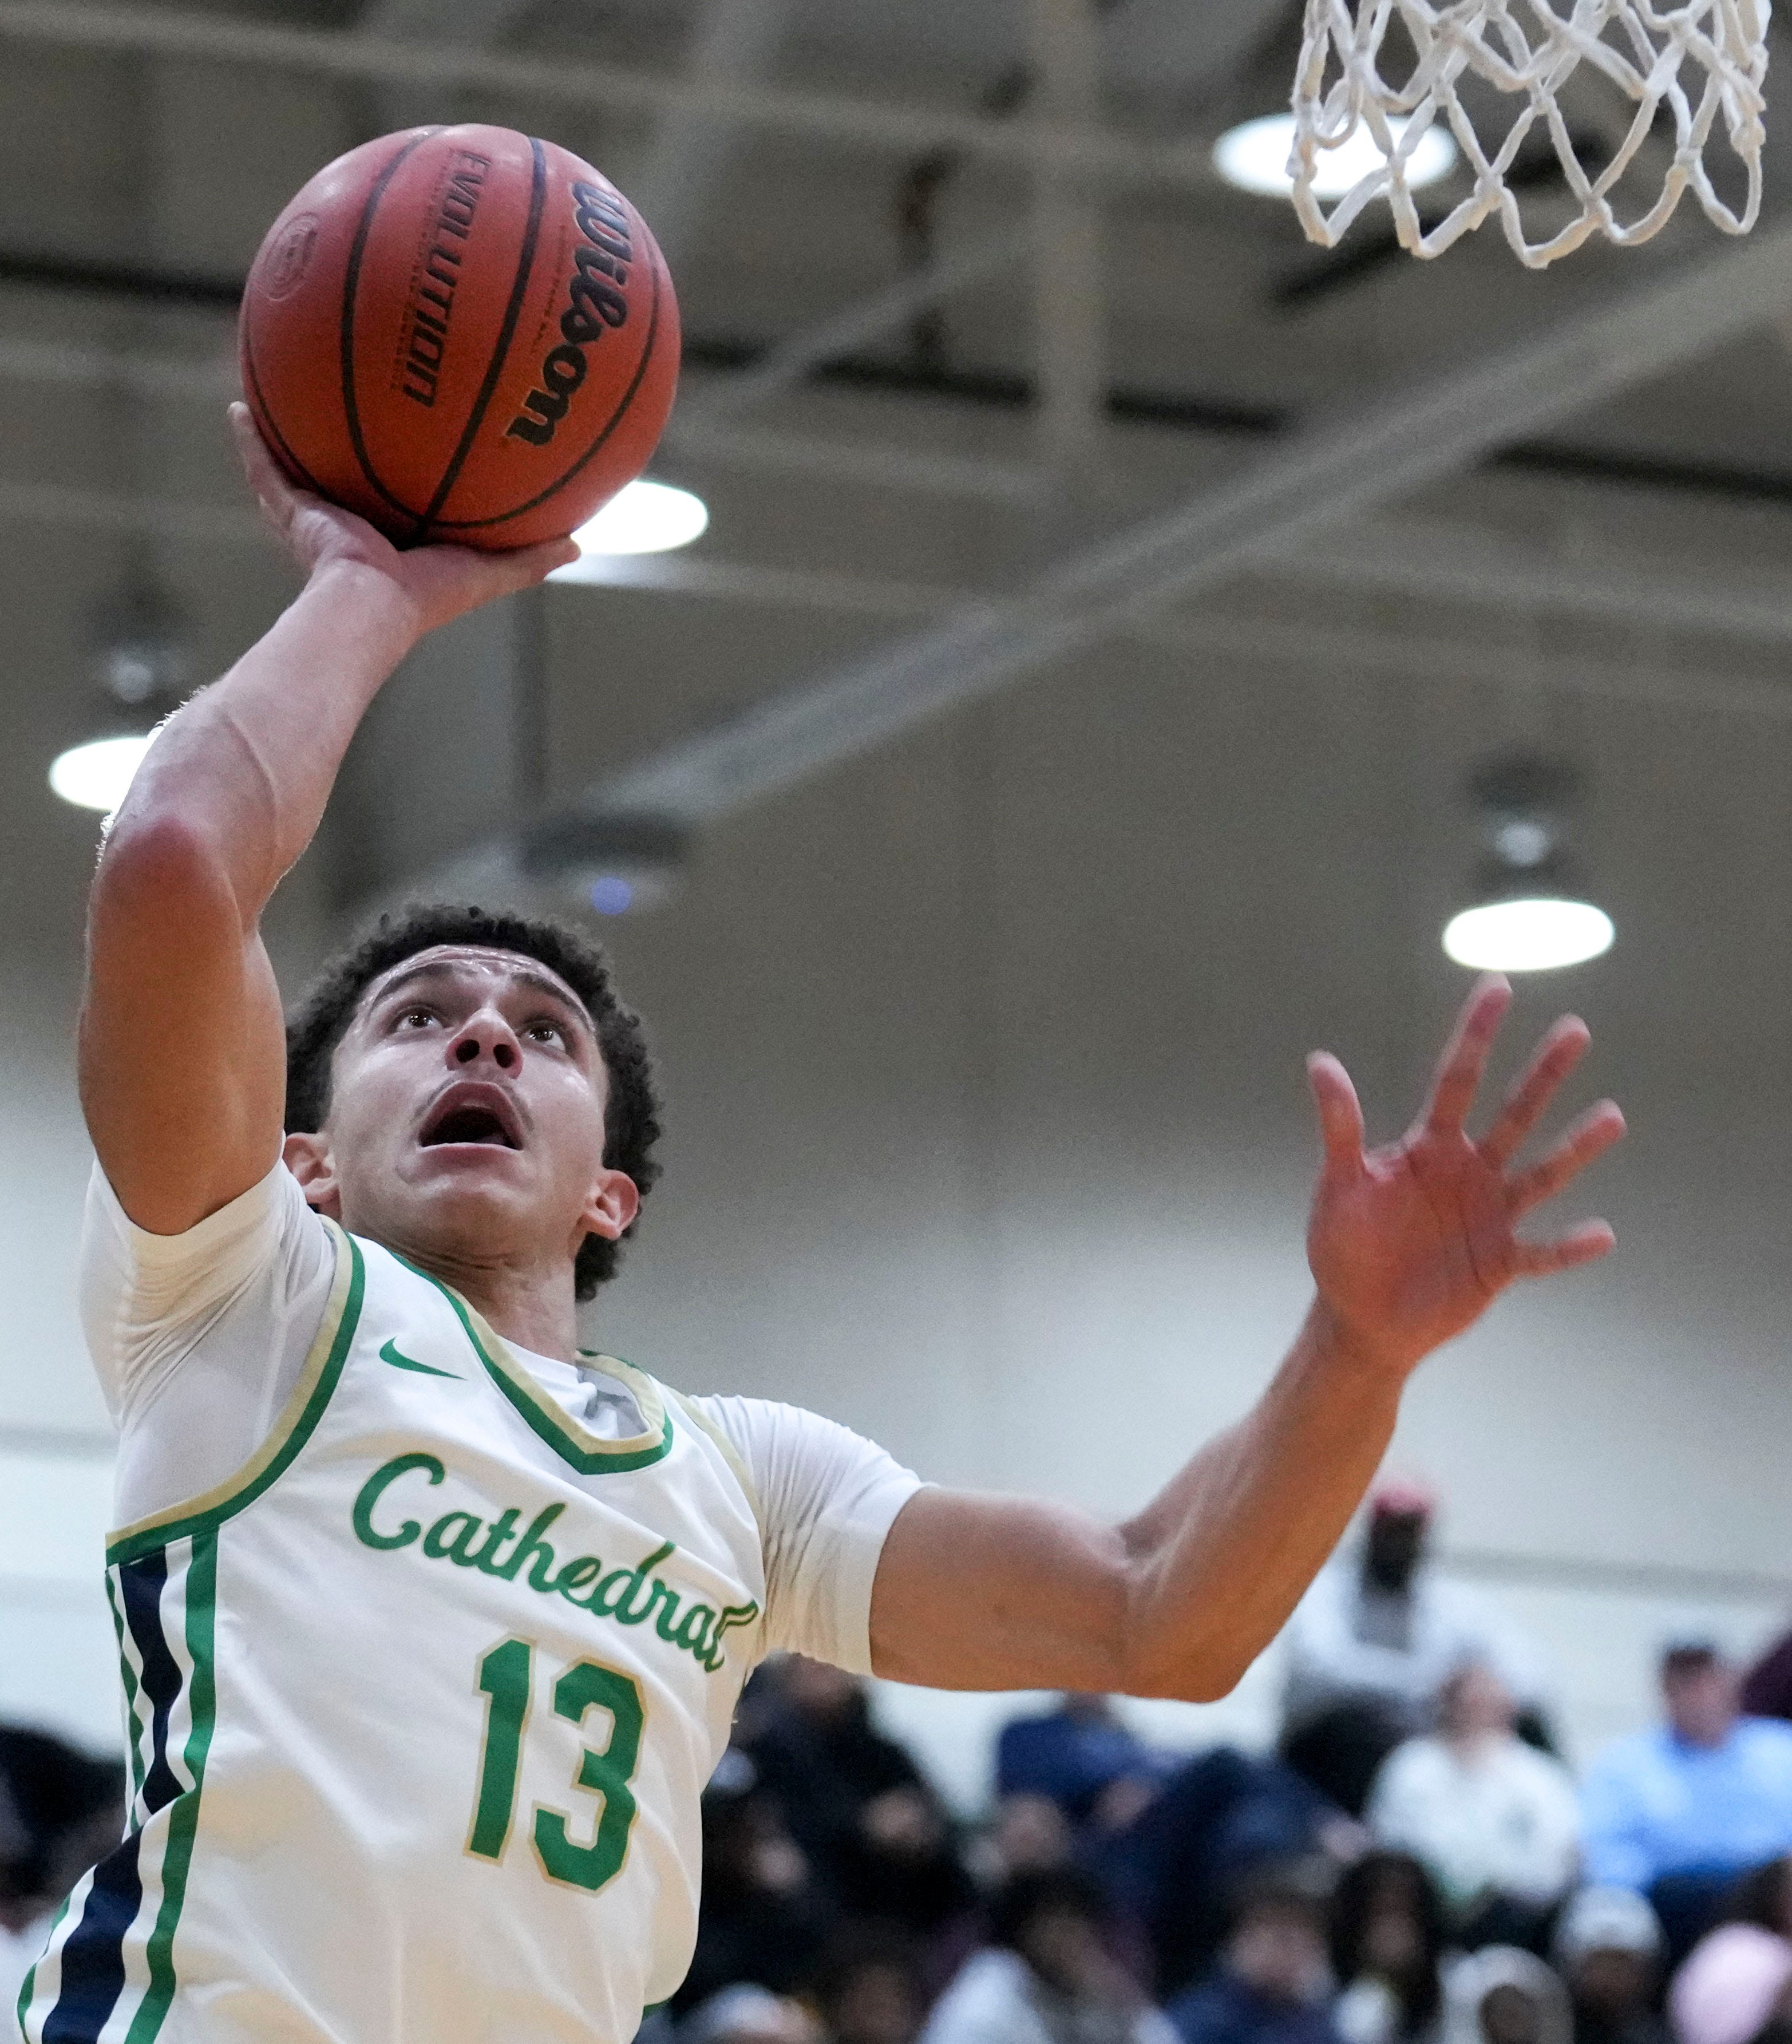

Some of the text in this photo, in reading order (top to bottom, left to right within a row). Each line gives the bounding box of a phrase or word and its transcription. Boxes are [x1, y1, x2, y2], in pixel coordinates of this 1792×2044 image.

[404, 149, 490, 408] EVOLUTION
[505, 181, 633, 446] Wilson
[353, 1452, 759, 1672] Cathedral
[465, 1636, 644, 1895] 13
